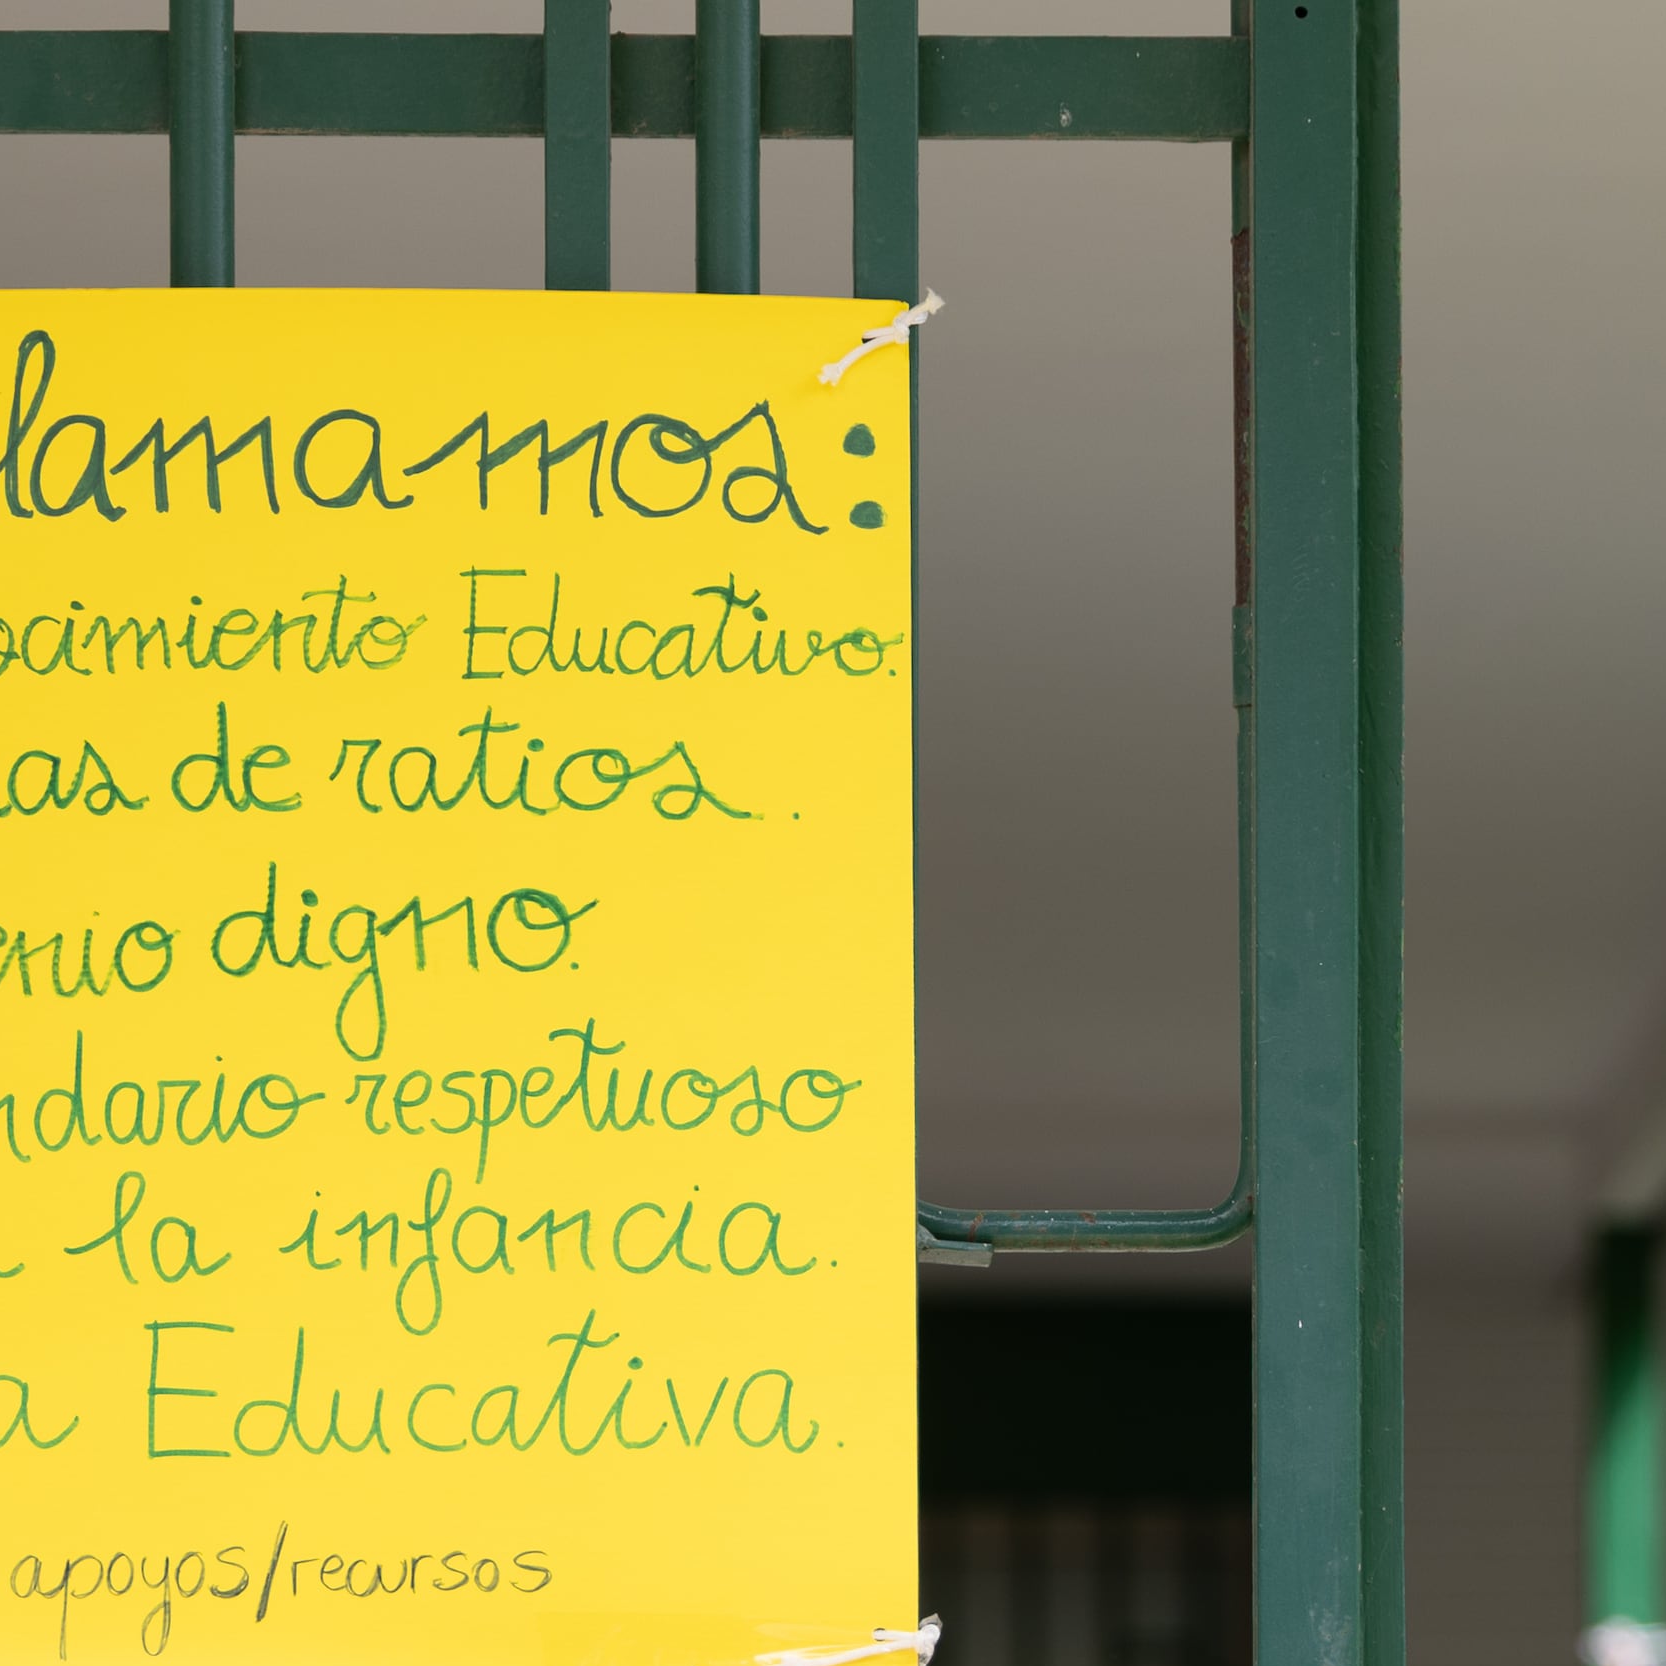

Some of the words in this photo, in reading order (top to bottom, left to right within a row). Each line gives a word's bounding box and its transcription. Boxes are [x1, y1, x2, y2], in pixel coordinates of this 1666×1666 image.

[459, 567, 905, 681] Educativo.
[169, 701, 302, 815] de
[209, 862, 598, 1061] digno.
[342, 1017, 862, 1185] respetuoso
[63, 1170, 231, 1284] la
[279, 1168, 842, 1336] infancia.
[143, 1308, 847, 1459] Educativa.
[8, 1519, 554, 1661] apoyos/recursos
